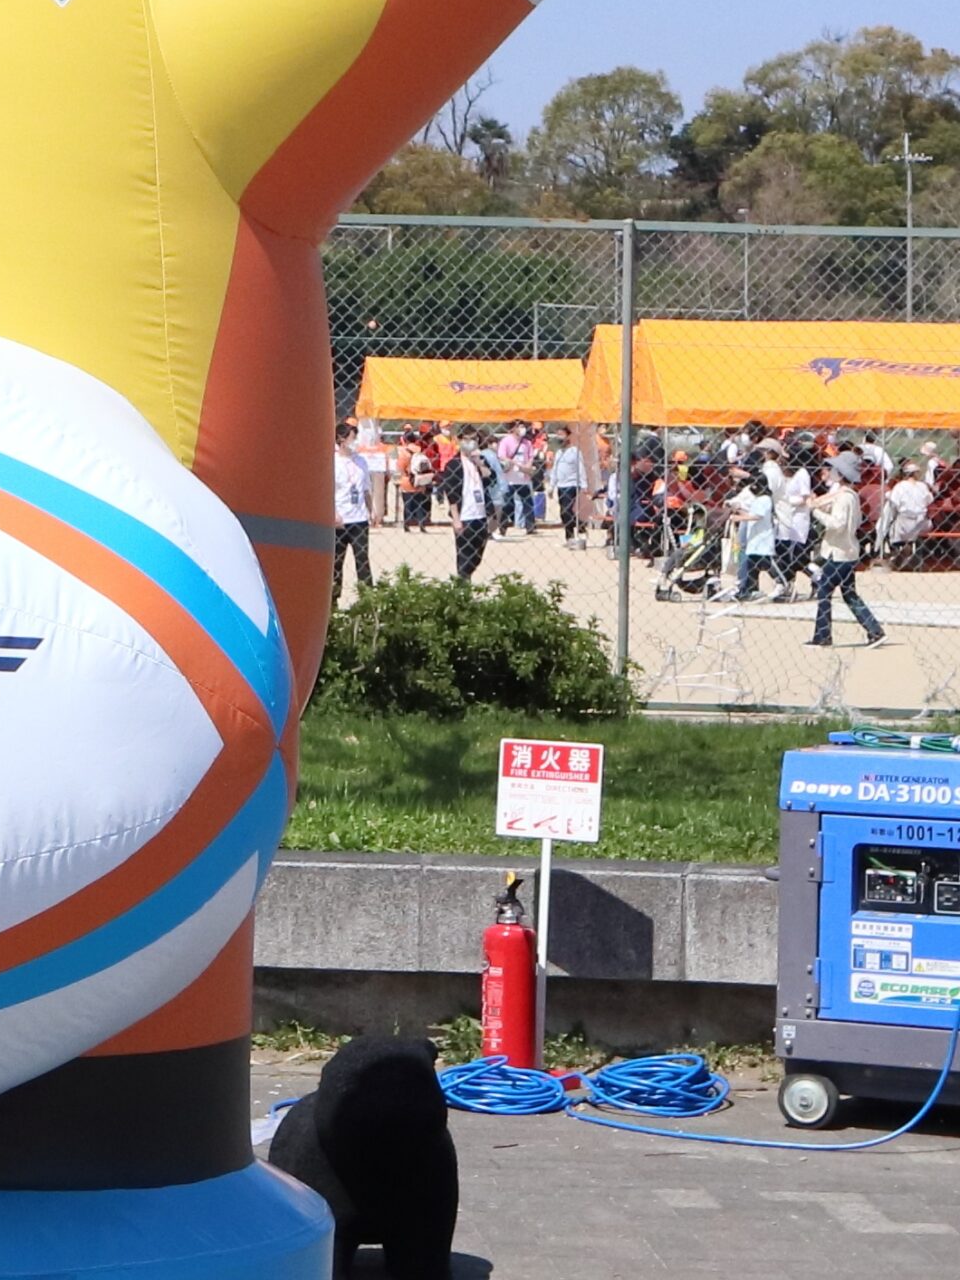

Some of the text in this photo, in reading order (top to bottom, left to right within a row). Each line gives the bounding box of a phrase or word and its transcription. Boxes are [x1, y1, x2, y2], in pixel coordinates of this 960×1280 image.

[511, 745, 591, 772] 消火器
[510, 768, 590, 780] FIRE EXTINGUISHER
[901, 775, 949, 784] GENERATOR
[790, 780, 852, 797] Denyo
[880, 982, 908, 993] ECO
